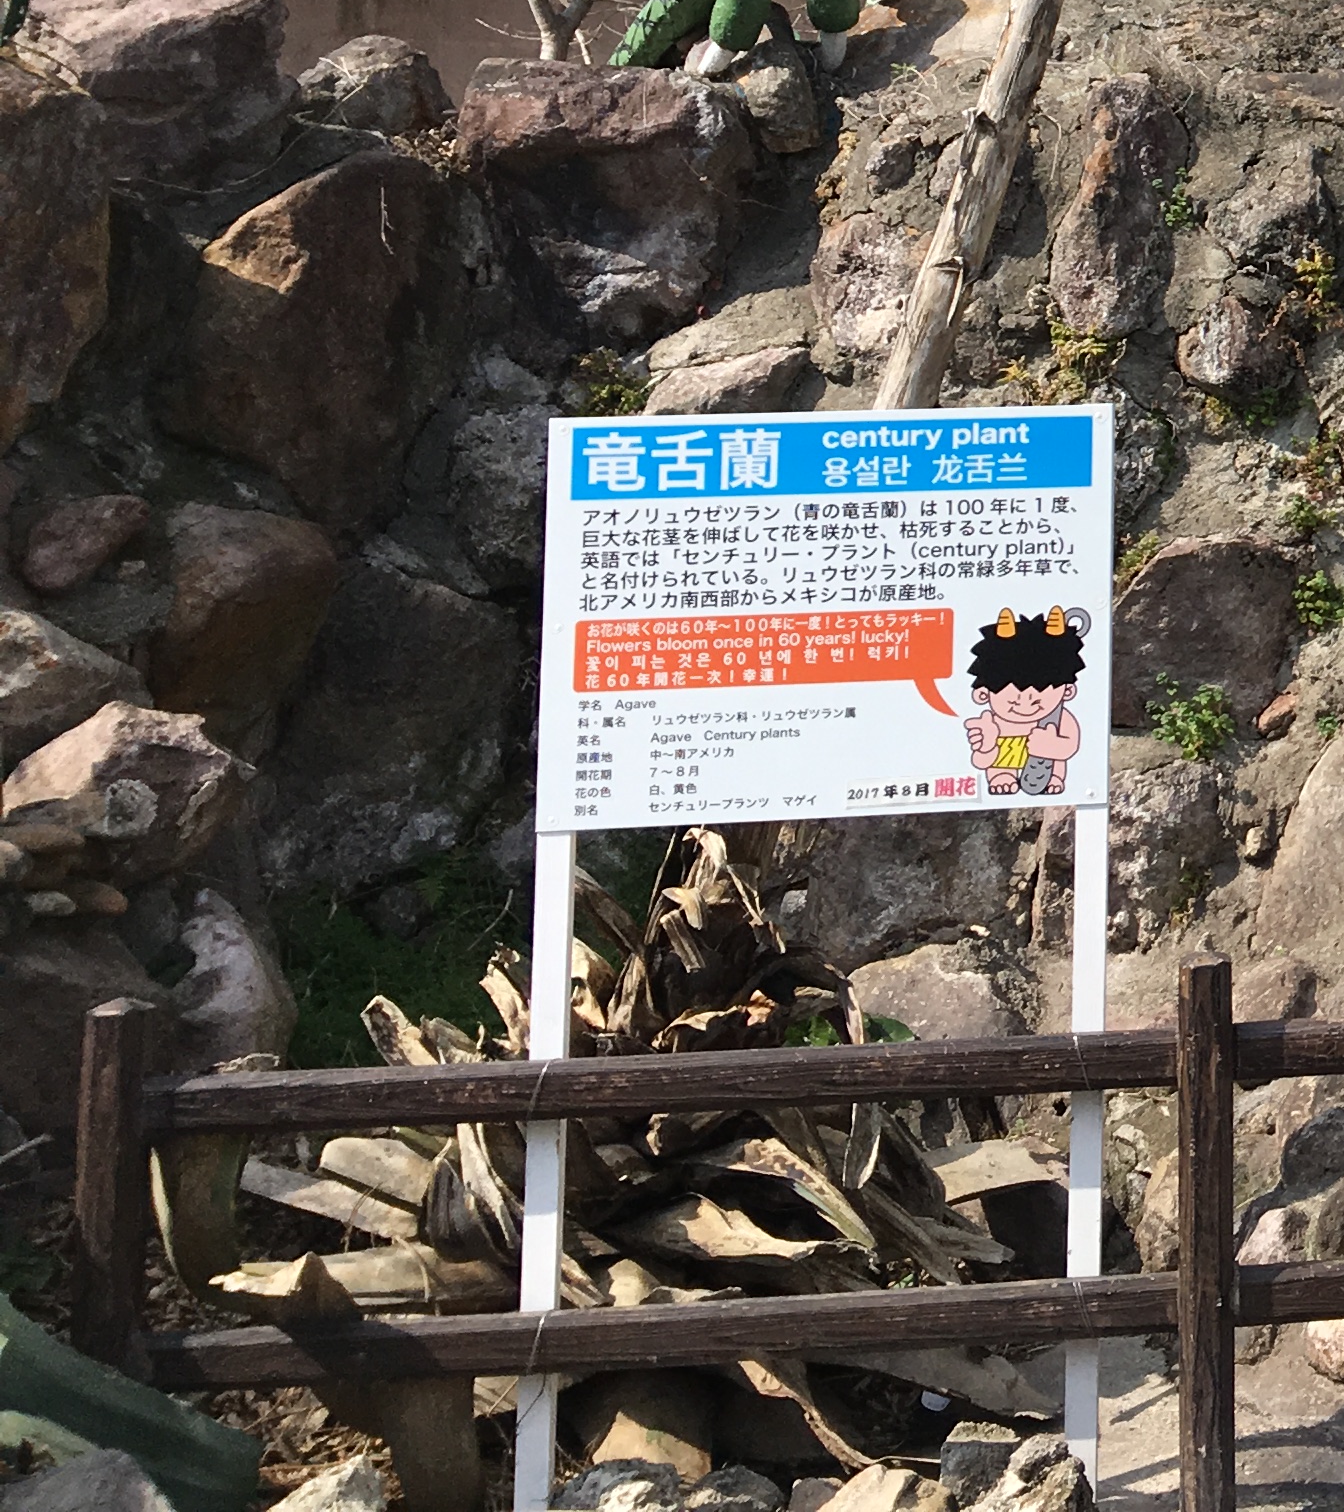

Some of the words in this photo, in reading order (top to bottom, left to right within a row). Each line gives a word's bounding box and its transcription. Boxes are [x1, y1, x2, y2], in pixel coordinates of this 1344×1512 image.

[822, 425, 943, 451] century
[951, 422, 1029, 449] plant
[582, 428, 782, 492] 竜舌蘭
[822, 456, 911, 487] 용설란
[931, 454, 1028, 485] 龙舌兰
[579, 584, 946, 612] 北アメリカ南西部からメキシコが原産地。
[586, 639, 651, 653] Flowers
[656, 637, 708, 651] bloom
[712, 637, 753, 649] once
[758, 634, 773, 647] in
[778, 633, 800, 646] 60
[804, 631, 855, 648] years!
[860, 629, 909, 645] lucky!
[585, 655, 619, 673] 꽃이
[631, 654, 665, 670] 피는
[678, 652, 711, 668] 것은
[722, 652, 746, 665] 60
[758, 649, 791, 666] 년에
[803, 648, 818, 664] 한
[578, 699, 602, 711] 学名
[614, 698, 656, 711] Agave
[576, 734, 601, 747] 英名
[650, 731, 692, 745] Agave
[703, 729, 757, 742] Century
[759, 726, 801, 741] plants
[576, 751, 613, 764] 原産地
[575, 769, 612, 782] 開花期
[574, 786, 612, 799] 花の色
[649, 782, 698, 796] 白、黄色
[573, 804, 599, 817] 別名
